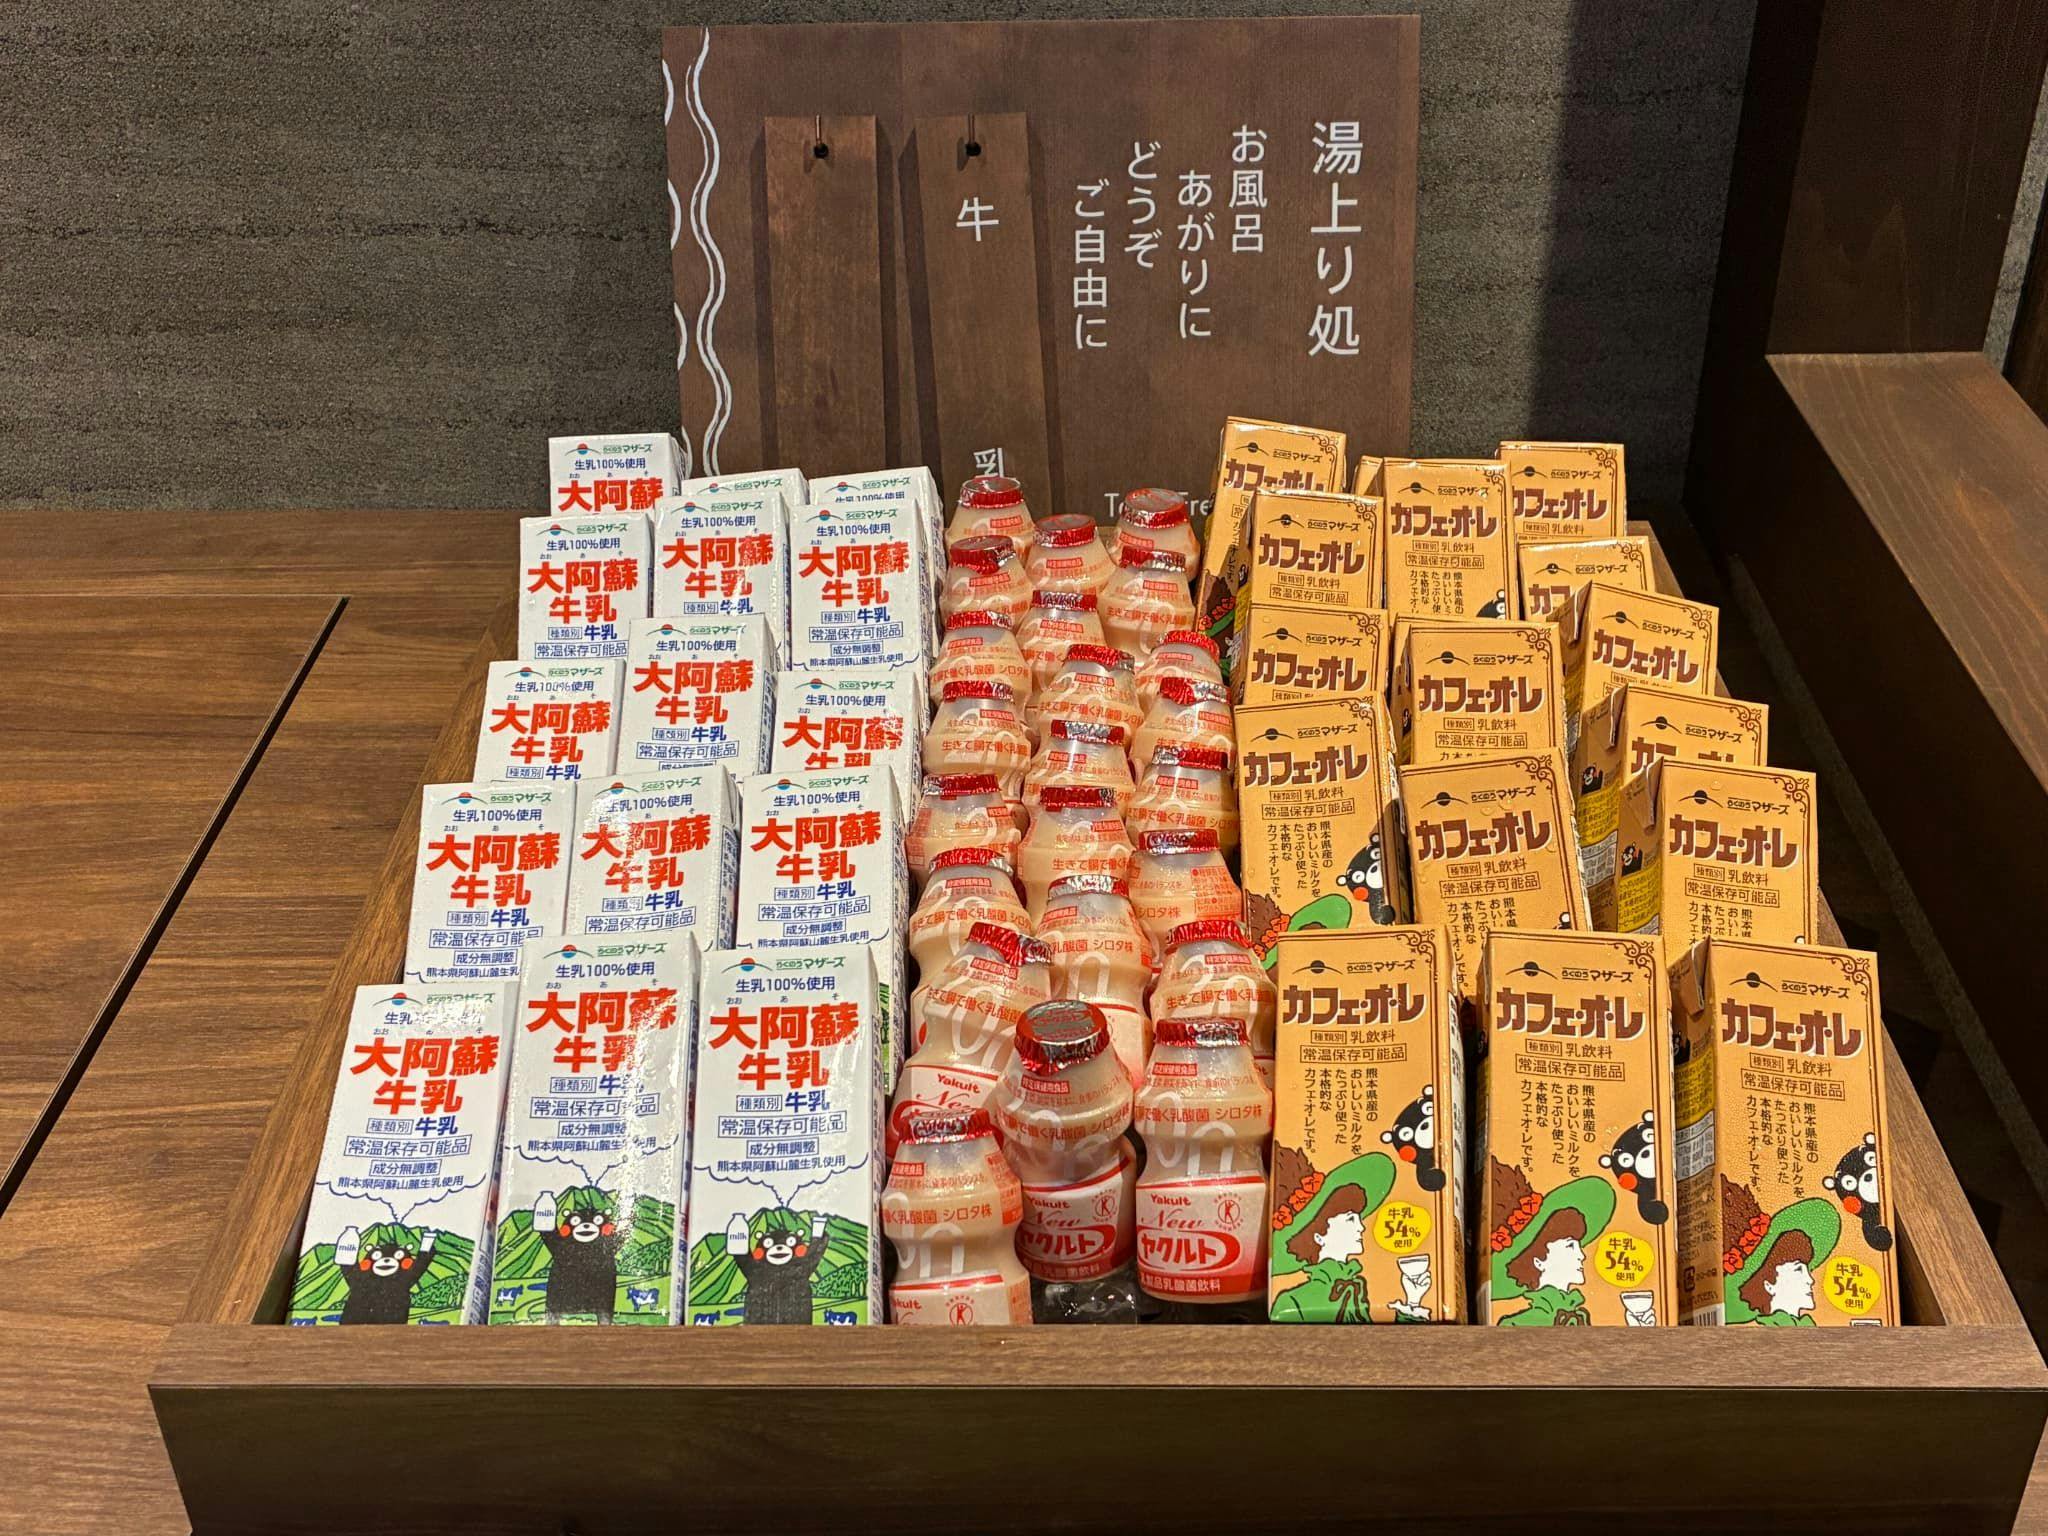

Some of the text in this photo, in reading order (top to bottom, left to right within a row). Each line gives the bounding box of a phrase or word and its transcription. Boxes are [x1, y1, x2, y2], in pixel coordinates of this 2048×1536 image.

[1229, 124, 1268, 254] お風呂
[1125, 141, 1161, 271] どうぞ
[956, 197, 1000, 242] 牛
[1308, 122, 1363, 358] 湯上り処
[1072, 179, 1108, 351] ご自由に
[1178, 170, 1216, 340] あがりに
[575, 458, 646, 470] 生乳100%使用
[558, 477, 663, 512] 大阿蘇
[681, 516, 755, 528] 生乳100%使用
[817, 523, 890, 536] 生乳100%使用
[1391, 502, 1497, 538] カフェ・オ・レ
[546, 538, 620, 551] 生乳100%使用
[663, 534, 773, 569] 大阿蘇
[1259, 533, 1365, 574] カフェ・オ・レ
[799, 541, 909, 578] 大阿蘇
[527, 558, 638, 594] 大阿蘇
[685, 570, 752, 598] 牛乳
[822, 577, 889, 607] 牛乳
[549, 595, 616, 624] 牛乳
[857, 607, 890, 624] 牛乳
[584, 625, 617, 640] 牛乳
[812, 624, 900, 640] 常温保存可能品
[537, 643, 627, 656] 常温保存可能品
[656, 640, 736, 652] 生乳100%使用
[1593, 629, 1699, 683] カフェ・オ・レ
[633, 659, 754, 695] 大阿蘇
[1251, 649, 1367, 691] カフェ・オ・レ
[515, 681, 594, 693] 生乳100%使用
[1418, 675, 1542, 713] カフェ・オ・レ
[655, 695, 729, 724] 牛乳
[806, 695, 886, 706] 生乳100%使用
[490, 701, 611, 735] 大阿蘇
[1477, 718, 1516, 731] 乳飲料
[691, 726, 727, 743] 牛乳
[783, 716, 903, 751] 大阿蘇
[1438, 734, 1525, 747] 常温保存可能品
[510, 736, 583, 764] 牛乳
[639, 742, 738, 759] 常温保存可能品
[546, 765, 581, 781] 牛乳
[1243, 745, 1368, 786] カフェ・オ・レ
[773, 791, 860, 807] 生乳100%使用
[1304, 786, 1344, 801] 乳飲料
[453, 809, 542, 822] 生乳100%使用
[1264, 800, 1353, 818] 常温保存可能品
[581, 814, 712, 860] 大阿蘇
[750, 811, 881, 852] 大阿蘇
[1280, 825, 1292, 862] 本格的な
[1416, 810, 1550, 861] カフェ・オ・レ
[1669, 813, 1798, 868] カフェ・オ・レ
[426, 833, 560, 872] 大阿蘇
[605, 857, 684, 893] 牛乳
[776, 850, 855, 884] 牛乳
[1484, 857, 1527, 875] 乳飲料
[1727, 870, 1768, 886] 乳飲料
[451, 874, 531, 908] 牛乳
[817, 881, 856, 900] 牛乳
[1442, 874, 1538, 896] 常温保存可能品
[1687, 882, 1778, 905] 常温保存可能品
[645, 890, 683, 911] 牛乳
[762, 899, 868, 920] 常温保存可能品
[491, 908, 529, 927] 牛乳
[588, 907, 694, 933] 常温保存可能品
[556, 962, 654, 978] 生乳100%使用
[1347, 959, 1416, 973] らくのうマザーズ
[1561, 969, 1634, 983] らくのうマザーズ
[736, 977, 835, 993] 生乳100%使用
[1782, 981, 1851, 999] らくのうマザーズ
[526, 988, 677, 1034] 大阿蘇
[1283, 983, 1425, 1024] カフェ・オ・レ
[1496, 987, 1644, 1040] カフェ・オ・レ
[709, 1002, 858, 1050] 大阿蘇
[1350, 1029, 1396, 1044] 乳飲料
[1721, 997, 1863, 1058] カフェ・オ・レ
[350, 1036, 499, 1078] 大阿蘇
[1303, 1046, 1405, 1061] 常温保存可能品
[1565, 1042, 1612, 1060] 乳飲料
[738, 1050, 829, 1091] 牛乳
[1518, 1058, 1623, 1079] 常温保存可能品
[1787, 1057, 1832, 1077] 乳飲料
[937, 1074, 980, 1093] Yakult
[1319, 1068, 1332, 1111] 本格的な
[1366, 1068, 1378, 1122] 熊本県産の
[1744, 1072, 1844, 1098] 常温保存可能品
[373, 1080, 463, 1115] 牛乳
[785, 1090, 829, 1113] 牛乳
[1334, 1068, 1347, 1145] たっぷり使った
[1536, 1080, 1548, 1128] 本格的な
[721, 1114, 843, 1135] 常温保存可能品
[1350, 1068, 1362, 1156] おいしいミルクを
[1551, 1082, 1565, 1165] たっぷり使った
[1582, 1085, 1596, 1143] 熊本県産の
[1760, 1097, 1773, 1146] 本格的な
[415, 1116, 458, 1137] 牛乳
[1567, 1084, 1581, 1178] おいしいミルクを
[1803, 1102, 1819, 1163] 熊本県産の
[348, 1137, 469, 1156] 常温保存可能品
[1774, 1100, 1790, 1185] たっぷり使った
[1789, 1102, 1805, 1198] おいしいミルクを
[943, 1204, 992, 1222] シロタ株
[1150, 1193, 1191, 1207] Yakult
[1388, 1207, 1414, 1219] 牛乳
[535, 1210, 556, 1218] milk
[1141, 1209, 1204, 1229] New
[728, 1232, 748, 1242] milk
[1384, 1220, 1421, 1238] 54%
[338, 1243, 358, 1252] milk
[1141, 1235, 1217, 1264] ヤクルト
[1608, 1237, 1636, 1253] 牛乳
[1606, 1250, 1644, 1274] 54%
[1835, 1262, 1864, 1277] 牛乳
[1833, 1276, 1872, 1298] 54%
